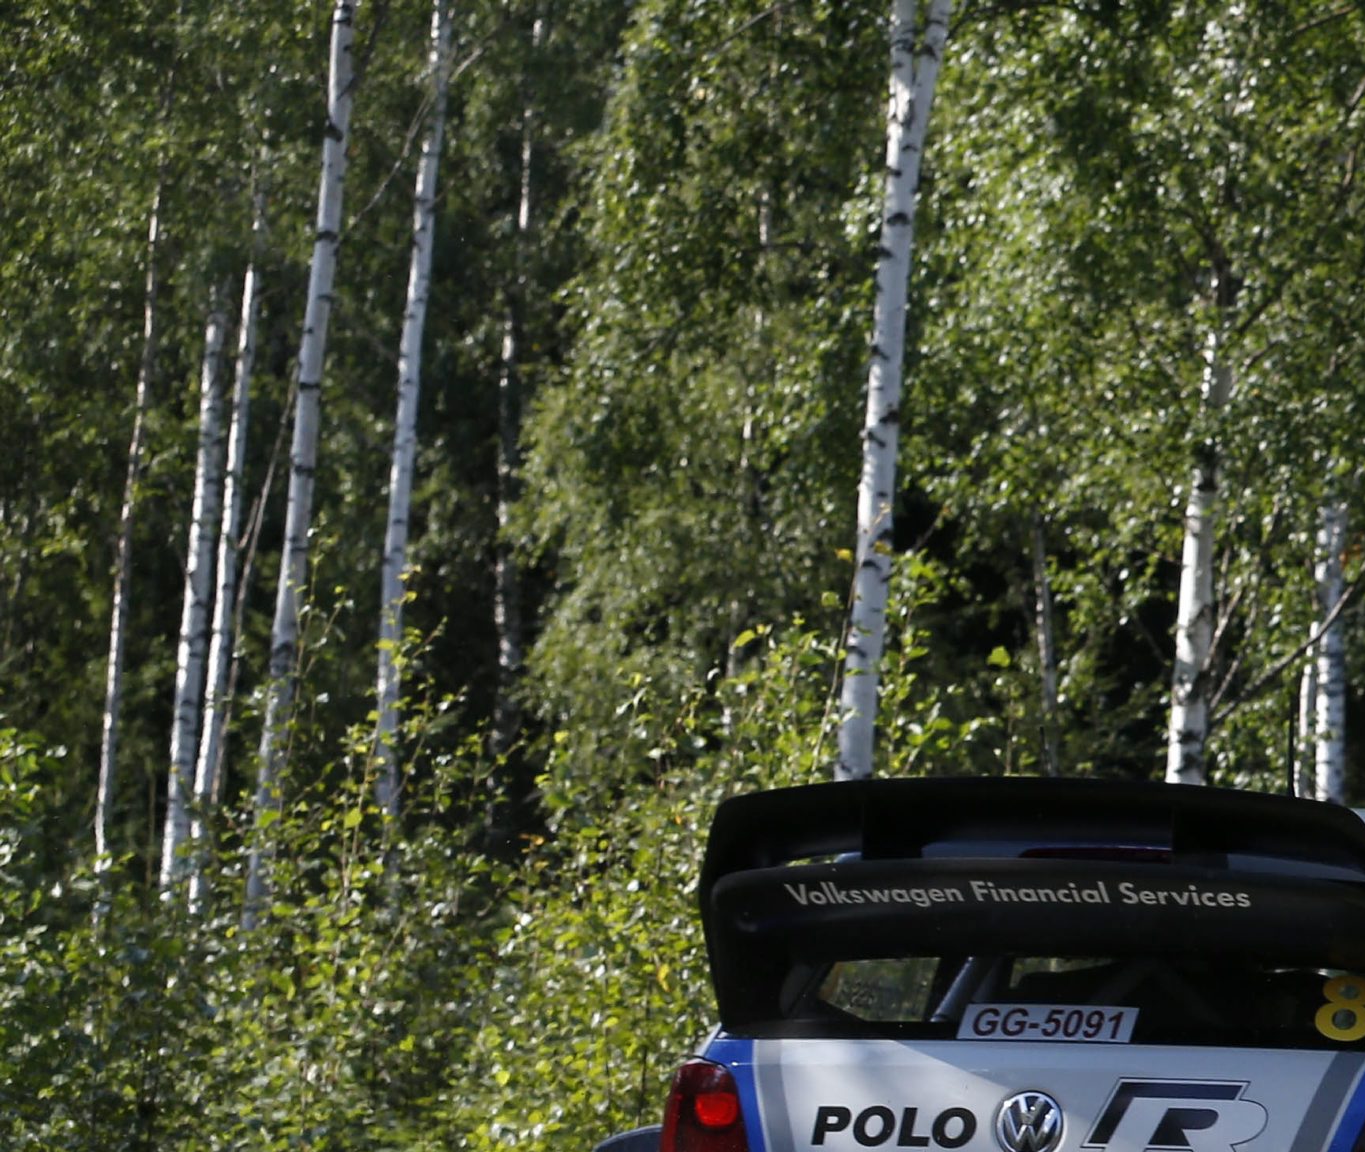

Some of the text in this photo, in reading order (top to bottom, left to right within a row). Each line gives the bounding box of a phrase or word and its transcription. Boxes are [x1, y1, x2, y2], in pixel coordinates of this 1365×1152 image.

[785, 880, 1252, 909] Volkswagen Financial Services
[971, 1007, 1125, 1041] GG-5091
[811, 1105, 977, 1149] POLO
